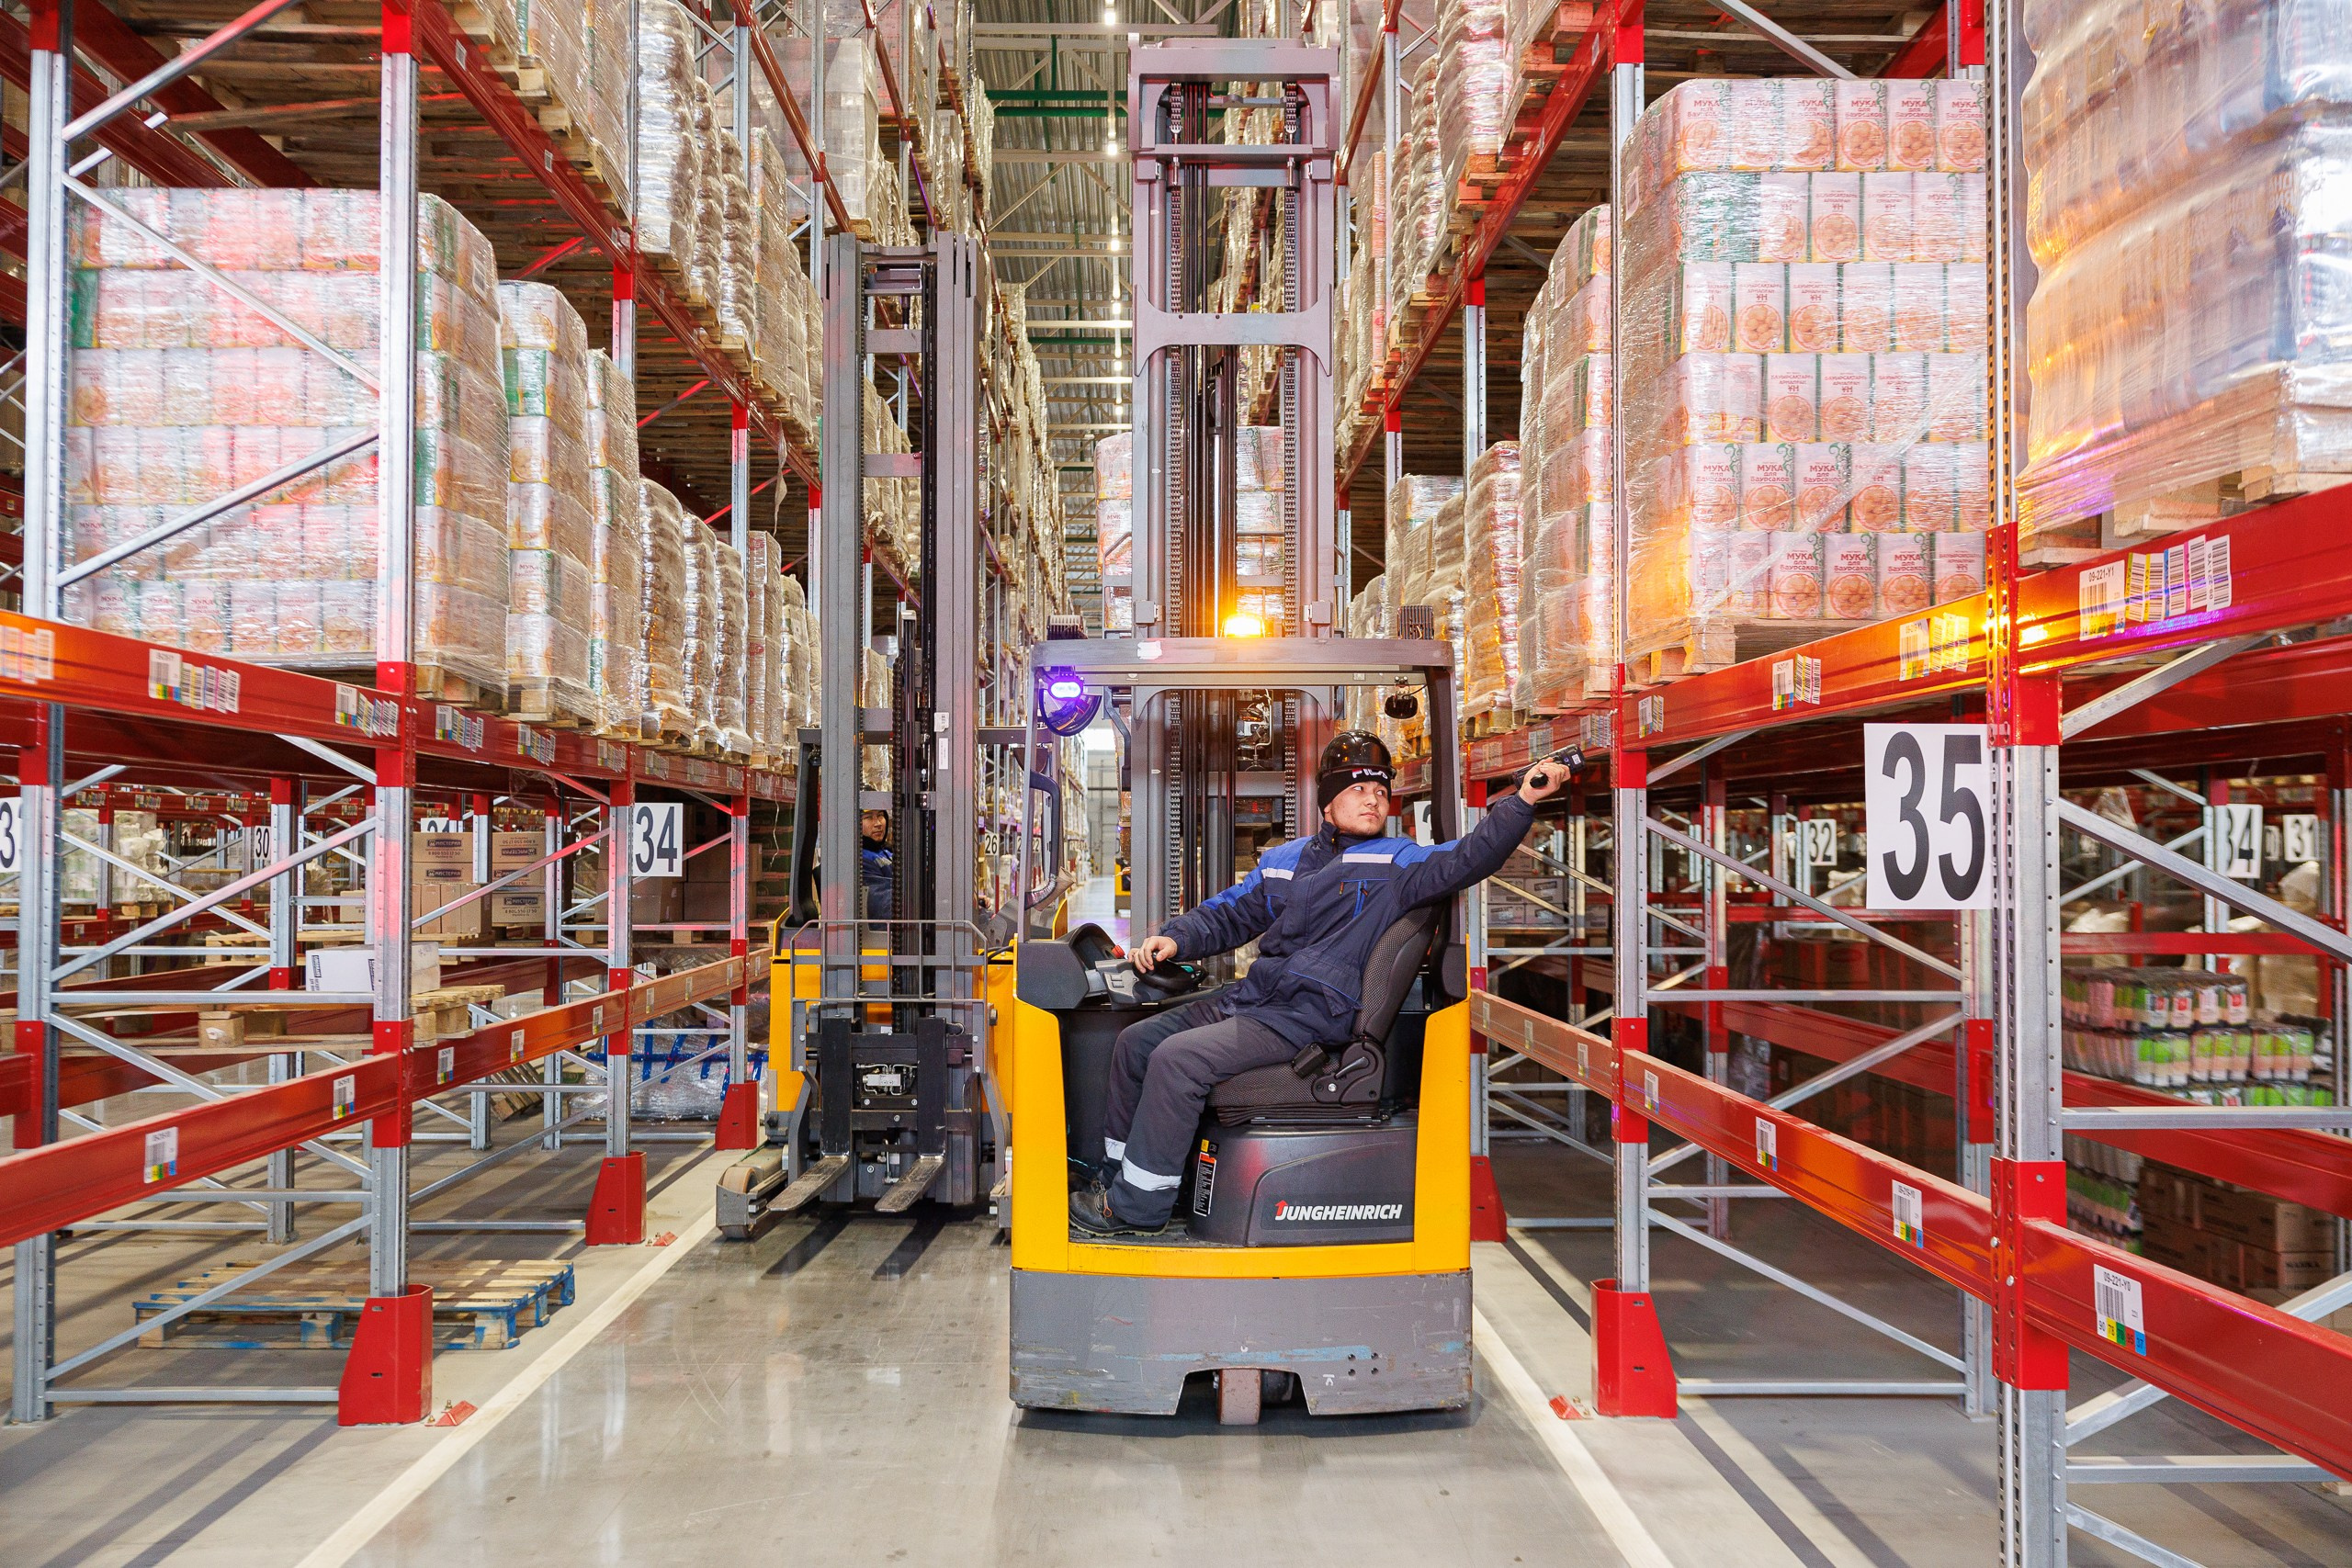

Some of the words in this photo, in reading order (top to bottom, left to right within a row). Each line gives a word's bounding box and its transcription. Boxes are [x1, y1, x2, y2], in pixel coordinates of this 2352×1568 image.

[1840, 553, 1867, 561] МУКА
[2088, 566, 2114, 582] 09-221-Y1
[1882, 731, 1985, 901] 35
[0, 801, 17, 869] 3
[255, 828, 270, 858] 30
[635, 806, 678, 873] 34
[985, 835, 998, 854] 26
[1810, 822, 1833, 863] 32
[1275, 1203, 1403, 1221] JUNGHEINRICH
